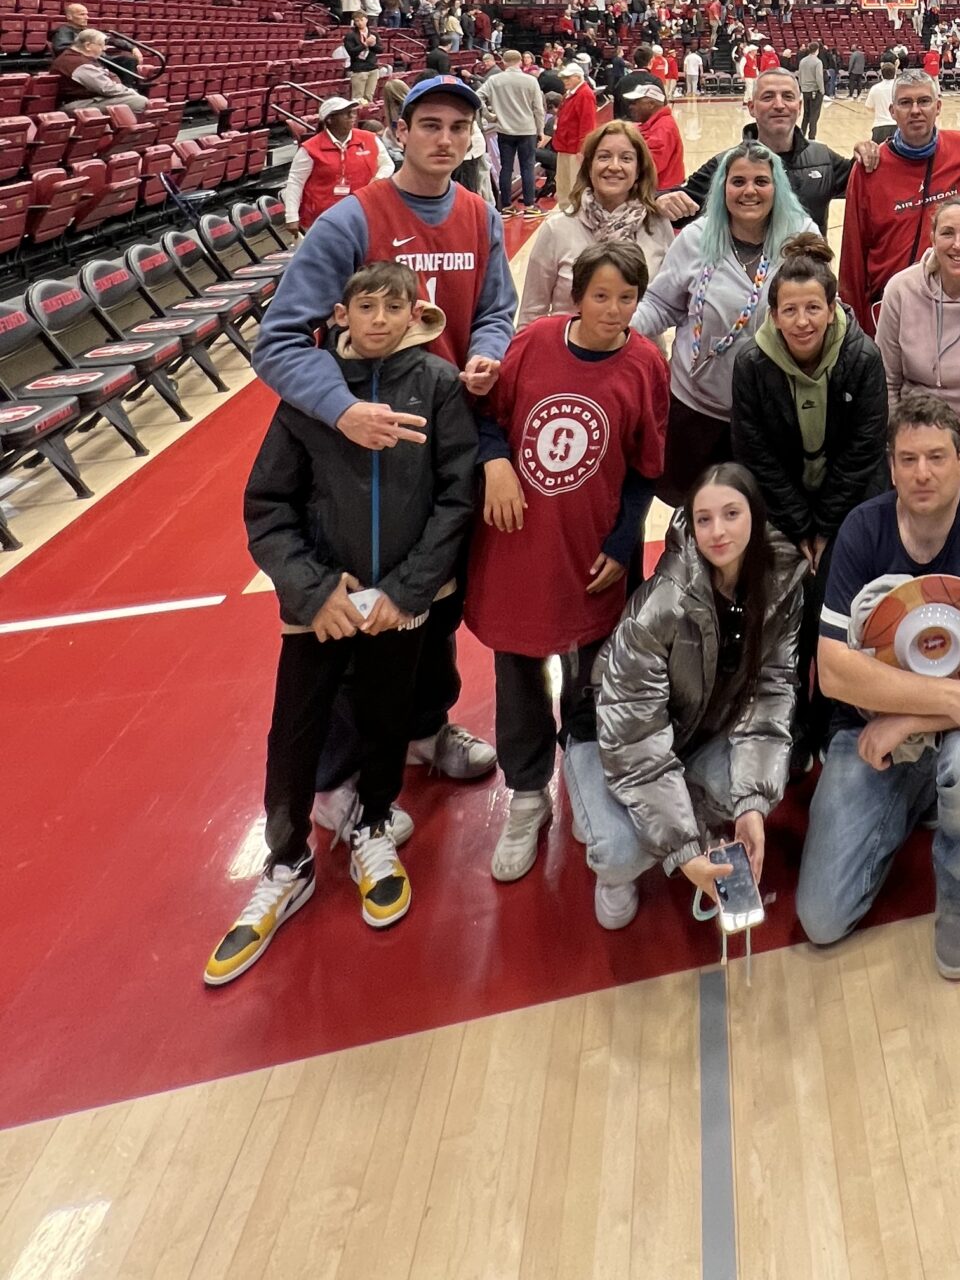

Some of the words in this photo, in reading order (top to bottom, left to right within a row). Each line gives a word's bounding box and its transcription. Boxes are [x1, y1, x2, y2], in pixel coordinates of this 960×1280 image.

[894, 201, 913, 211] AIR
[395, 252, 475, 272] STANFORD
[532, 404, 600, 441] STANFORD
[524, 448, 596, 486] CARDINAL
